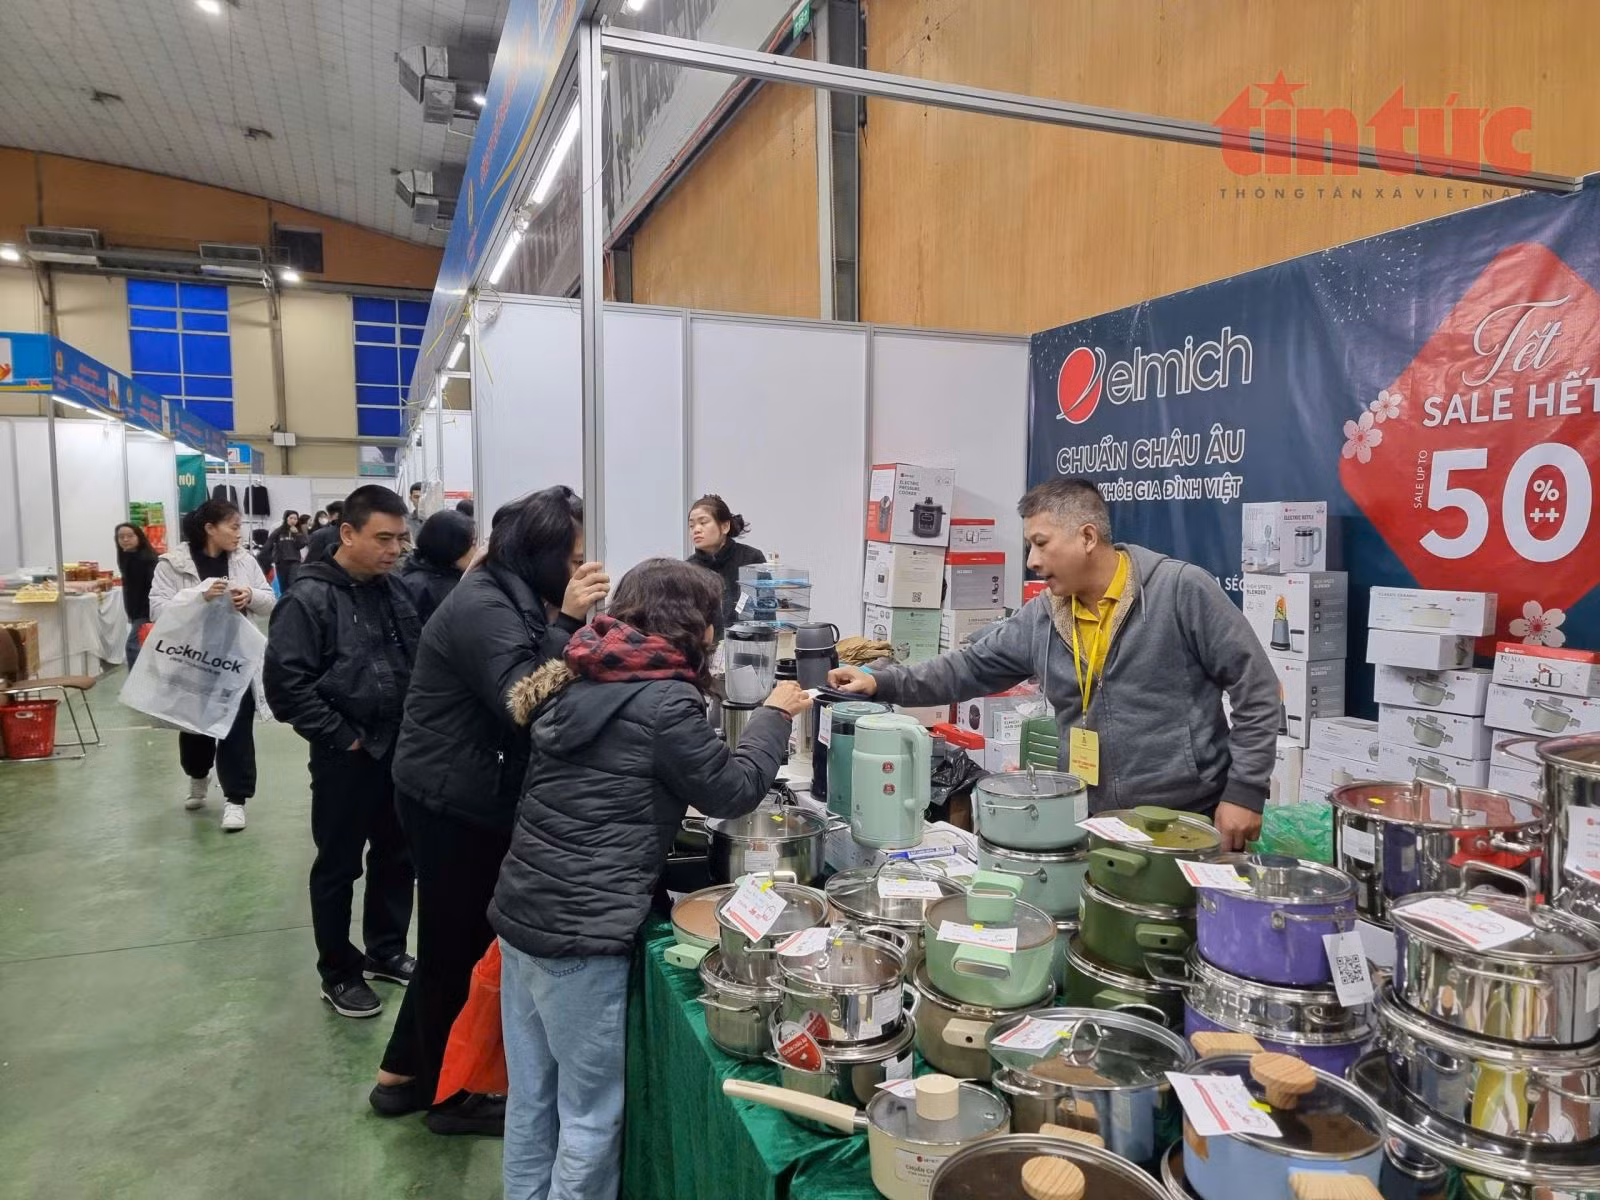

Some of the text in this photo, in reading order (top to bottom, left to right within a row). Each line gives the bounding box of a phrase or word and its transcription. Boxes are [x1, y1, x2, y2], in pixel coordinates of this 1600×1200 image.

[1106, 325, 1253, 405] elmich
[1462, 294, 1570, 387] Tết
[1423, 387, 1514, 428] SALE
[1056, 423, 1246, 475] CHUẨN CHÂU ÂU
[179, 472, 195, 487] NỘI
[1134, 478, 1161, 501] GIA
[1163, 474, 1201, 501] ĐÌNH
[1204, 471, 1243, 504] VIỆT
[1413, 450, 1428, 509] SALE UP TO
[1419, 442, 1593, 563] 50
[155, 639, 243, 674] LocknLock
